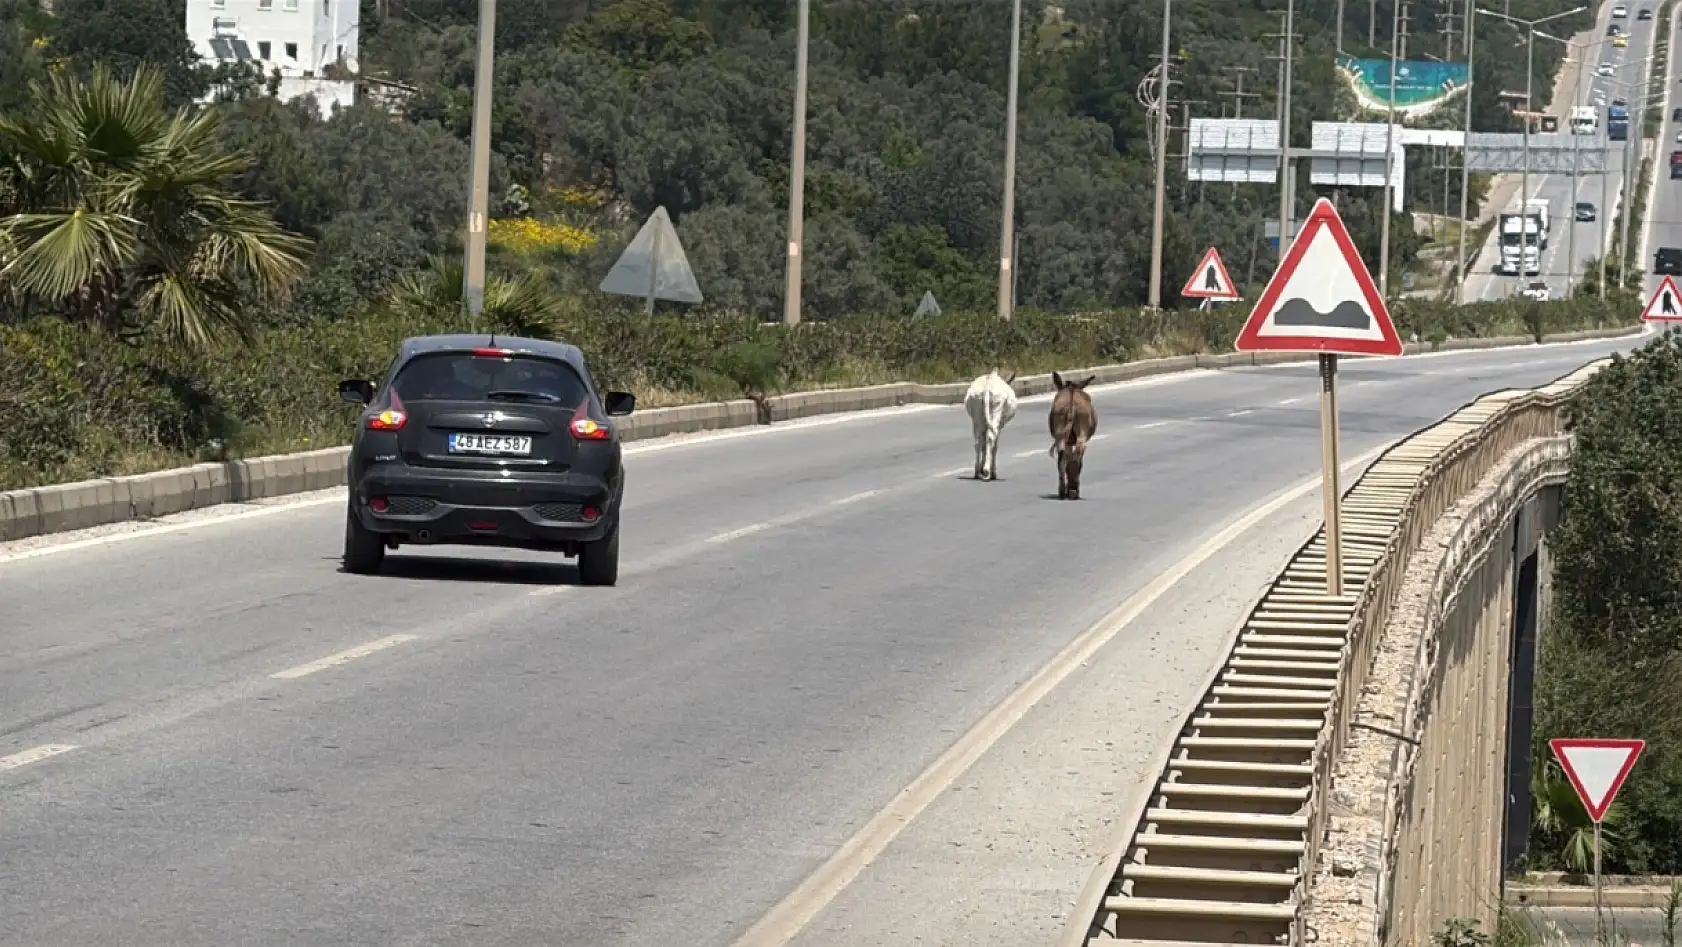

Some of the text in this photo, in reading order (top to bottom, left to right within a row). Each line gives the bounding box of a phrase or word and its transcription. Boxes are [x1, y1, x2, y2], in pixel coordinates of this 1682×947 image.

[457, 434, 529, 450] 48 AEZ 587
